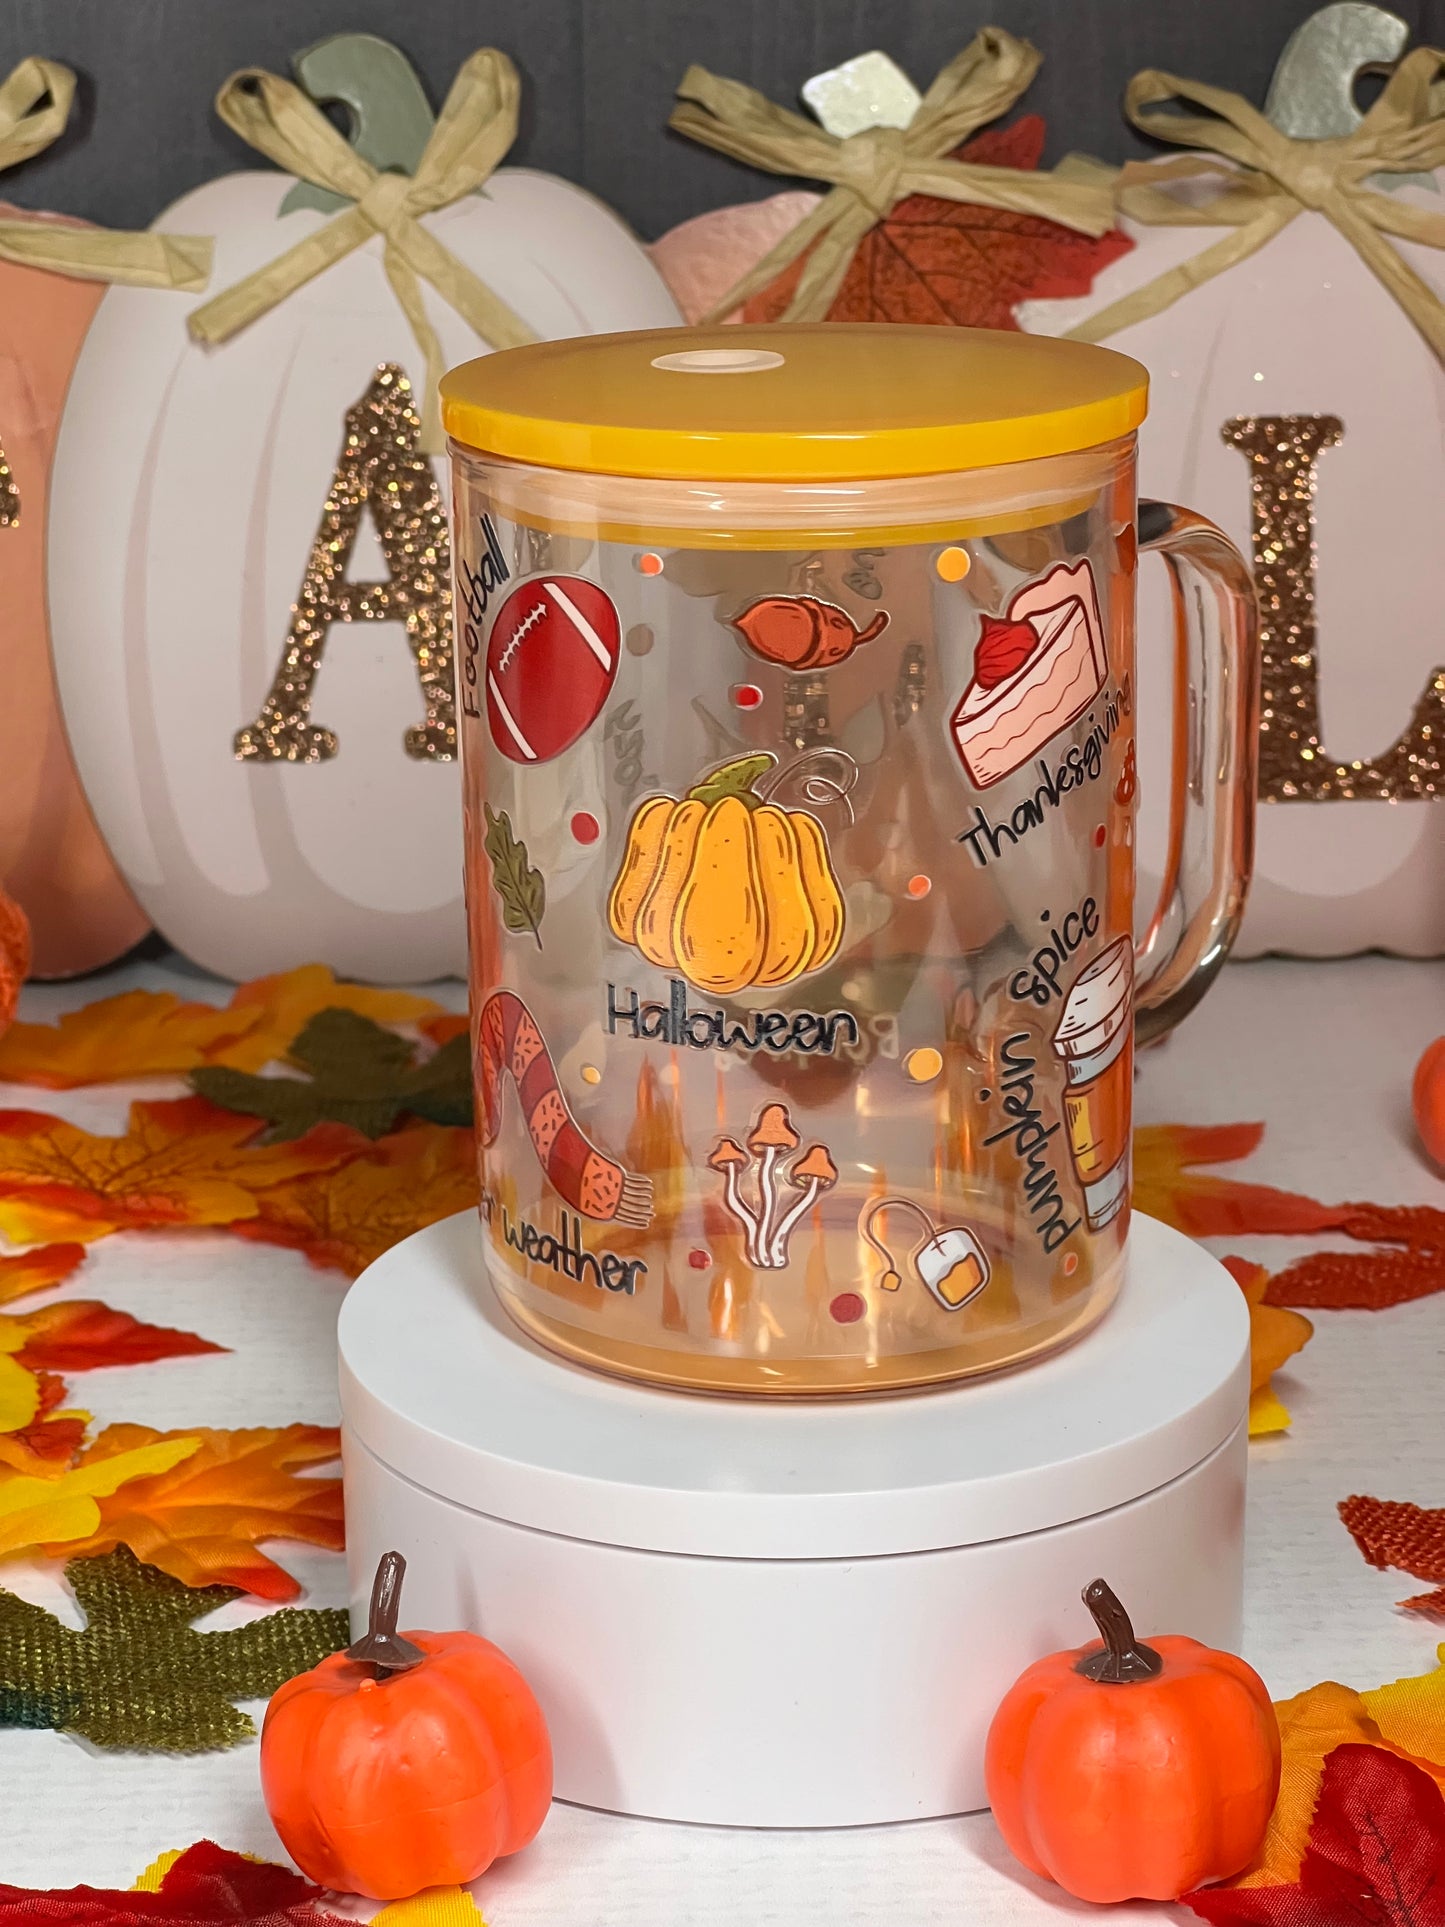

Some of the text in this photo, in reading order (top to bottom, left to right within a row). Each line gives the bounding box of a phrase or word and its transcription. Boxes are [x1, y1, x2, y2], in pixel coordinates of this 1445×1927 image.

[233, 361, 459, 762] A
[461, 512, 511, 719] Football
[1219, 412, 1445, 803] L
[606, 978, 859, 1055] Halloween
[980, 897, 1099, 1254] pumpkin spice
[502, 1207, 649, 1296] weather
